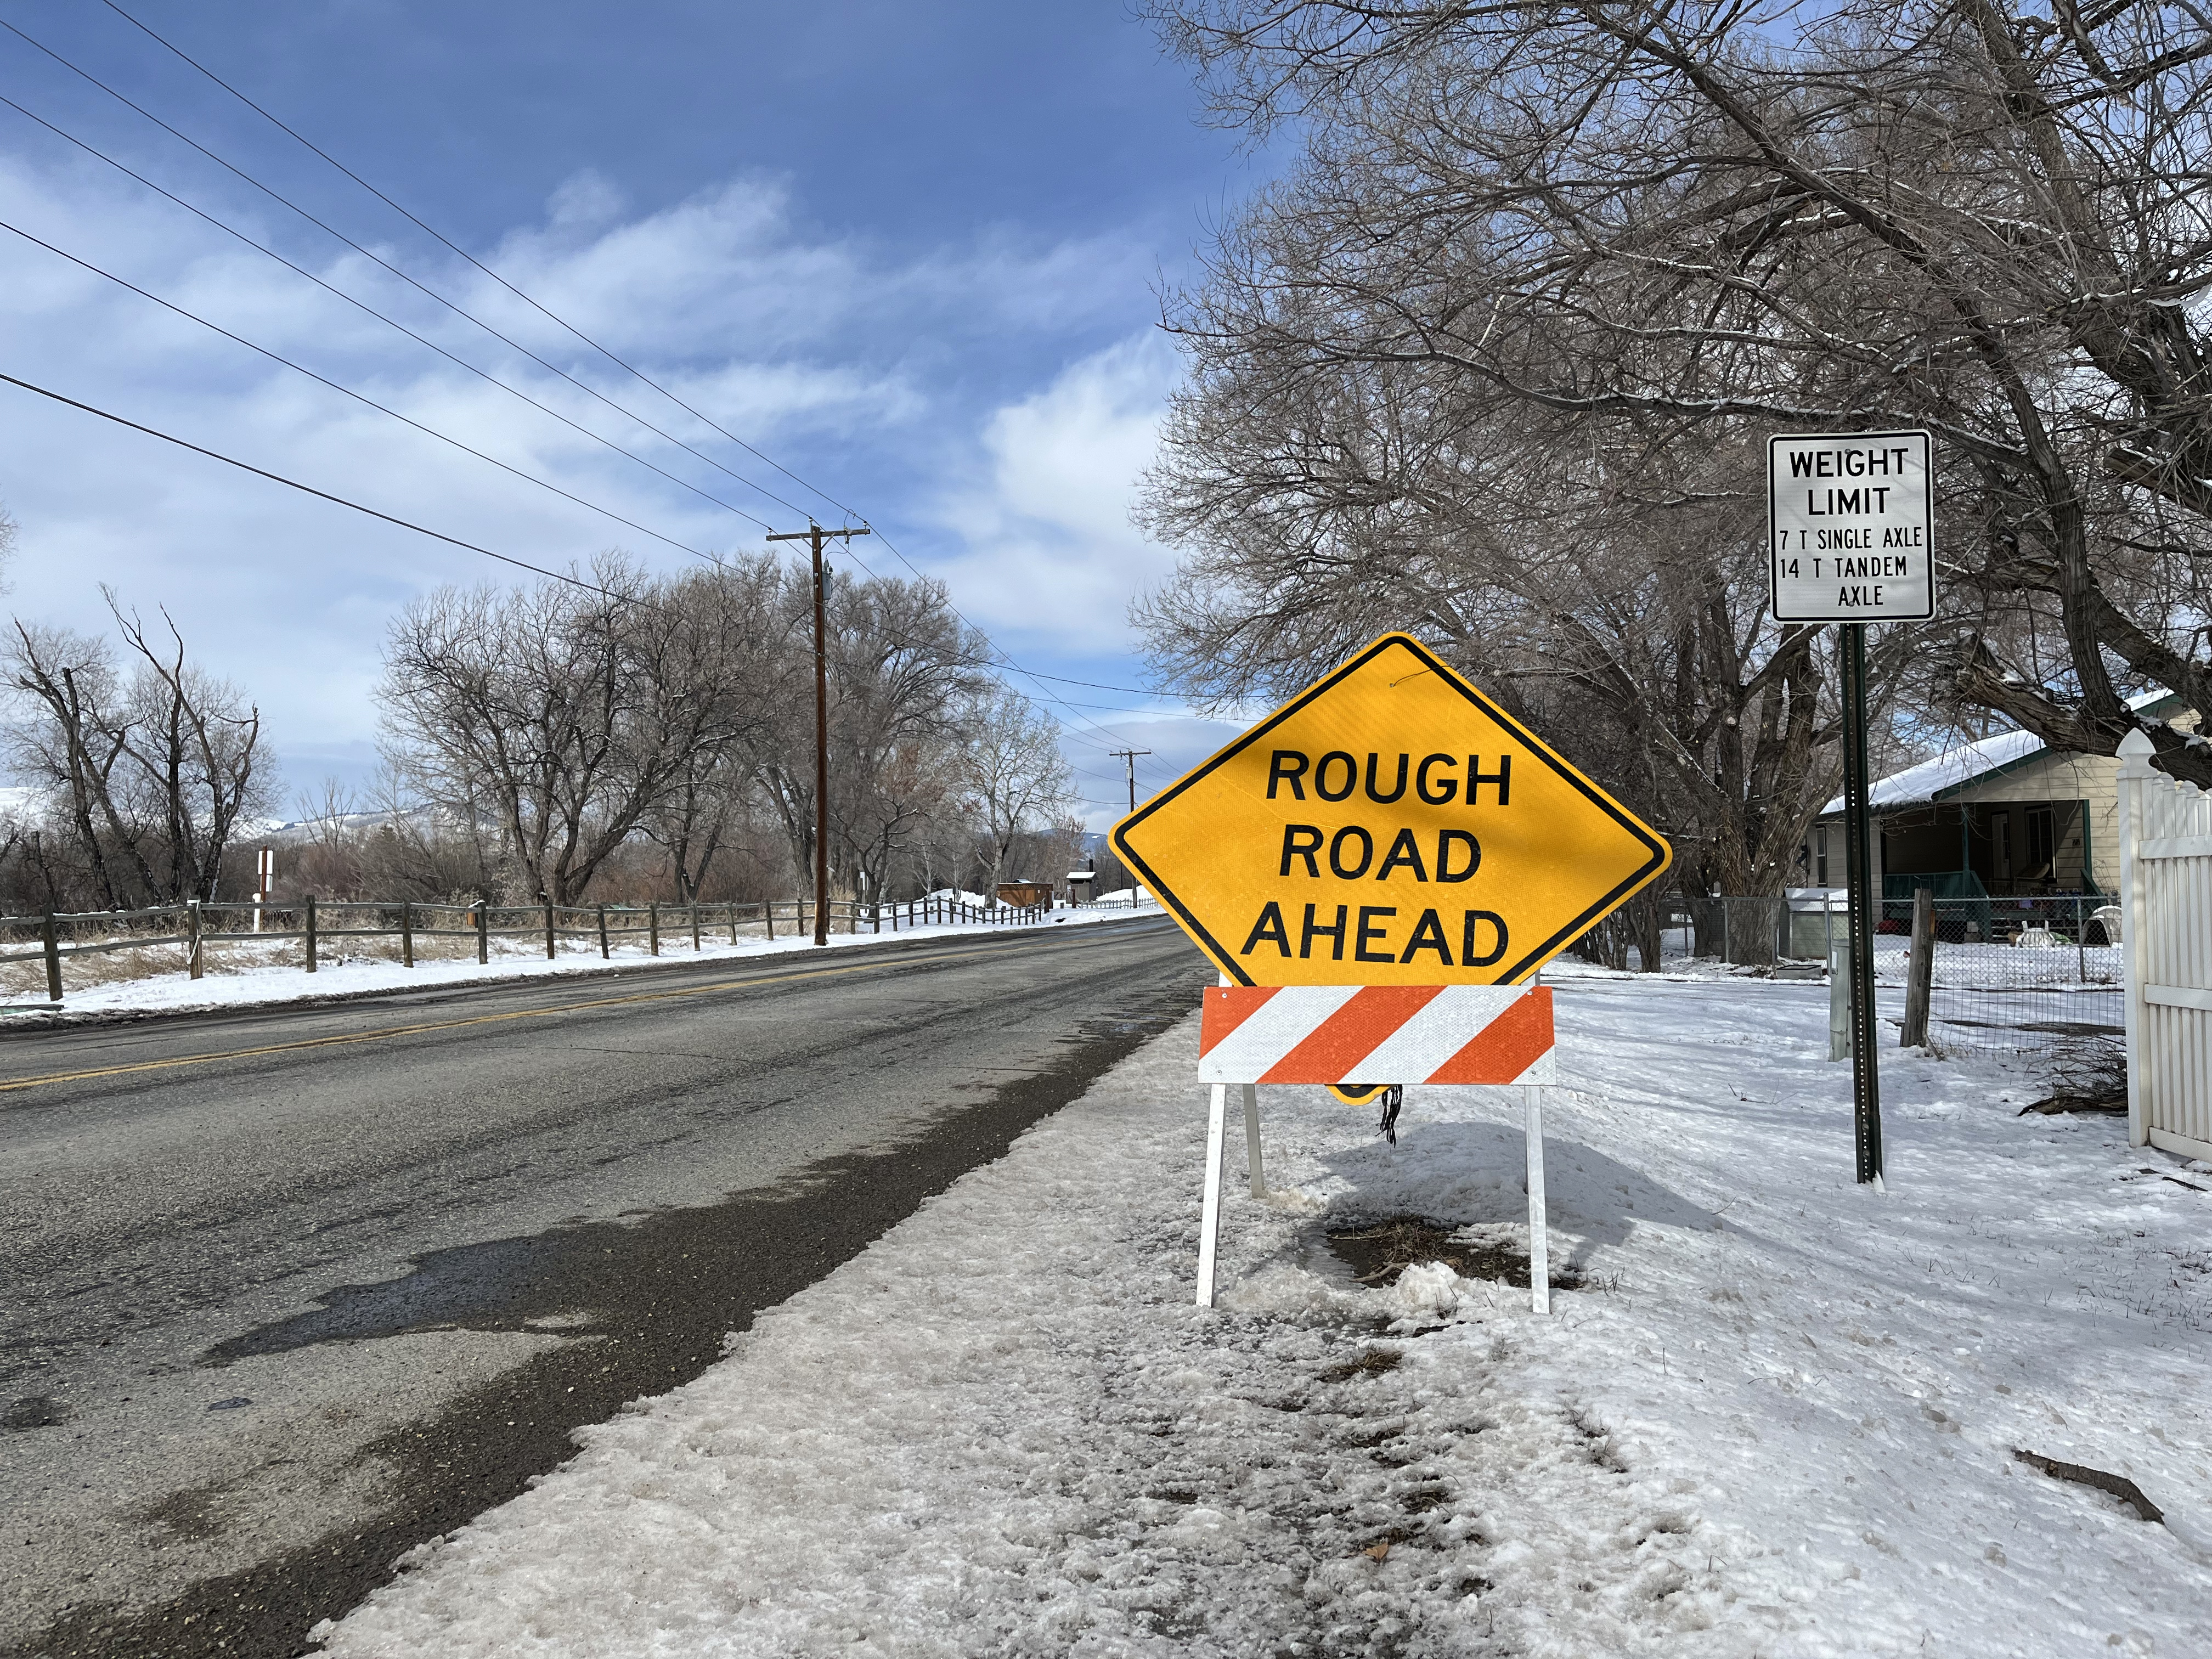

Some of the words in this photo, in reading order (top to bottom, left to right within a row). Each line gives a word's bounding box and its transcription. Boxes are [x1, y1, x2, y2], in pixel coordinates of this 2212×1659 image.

[1790, 448, 1909, 477] WEIGHT
[1808, 487, 1890, 515] LIMIT
[1780, 530, 1788, 550] 7
[1799, 530, 1807, 549] T
[1818, 528, 1872, 549] SINGLE
[1883, 527, 1922, 548] AXLE
[1780, 558, 1799, 578] 14
[1813, 558, 1821, 578] T
[1834, 556, 1906, 578] TANDEM
[1838, 585, 1883, 607] AXLE
[1266, 749, 1511, 806] ROUGH
[1279, 824, 1481, 883] ROAD
[1240, 901, 1509, 967] AHEAD
